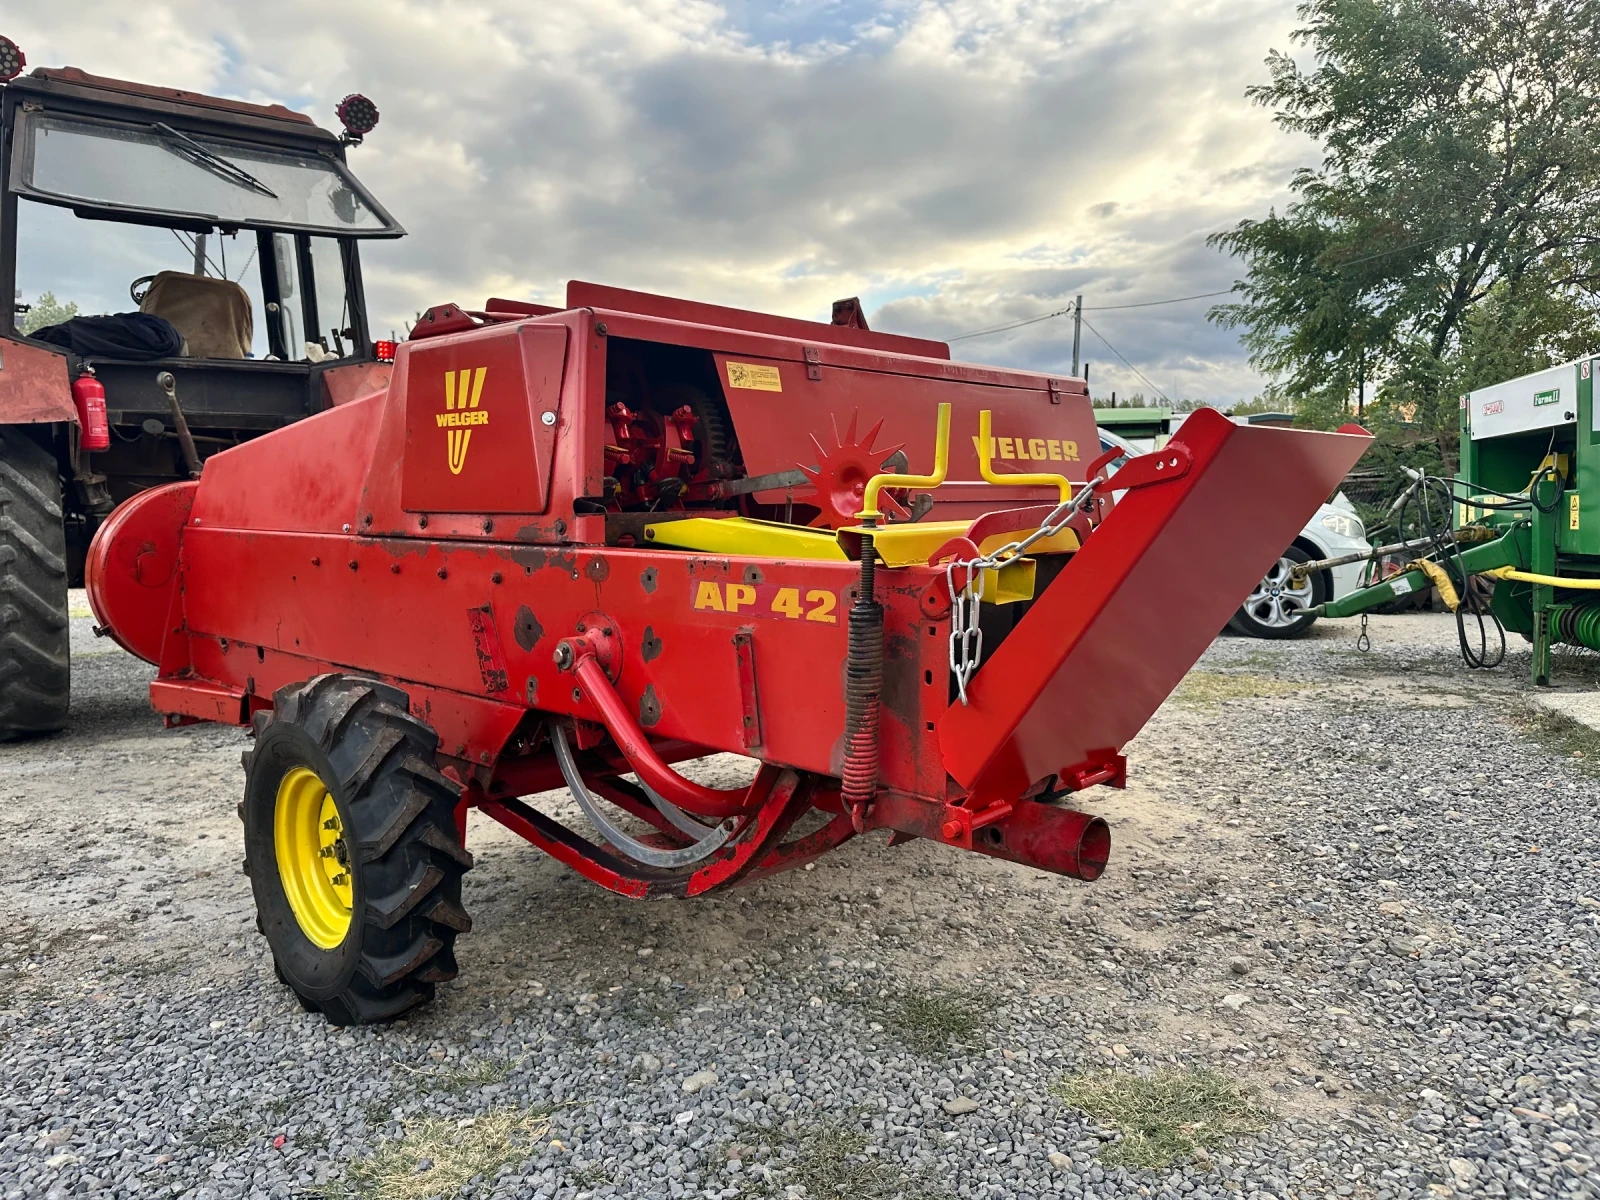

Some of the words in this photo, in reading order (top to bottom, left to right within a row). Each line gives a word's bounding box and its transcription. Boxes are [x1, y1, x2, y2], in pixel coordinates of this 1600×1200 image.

[436, 411, 489, 427] WELGER
[694, 581, 757, 613] AP
[771, 587, 837, 623] 42
